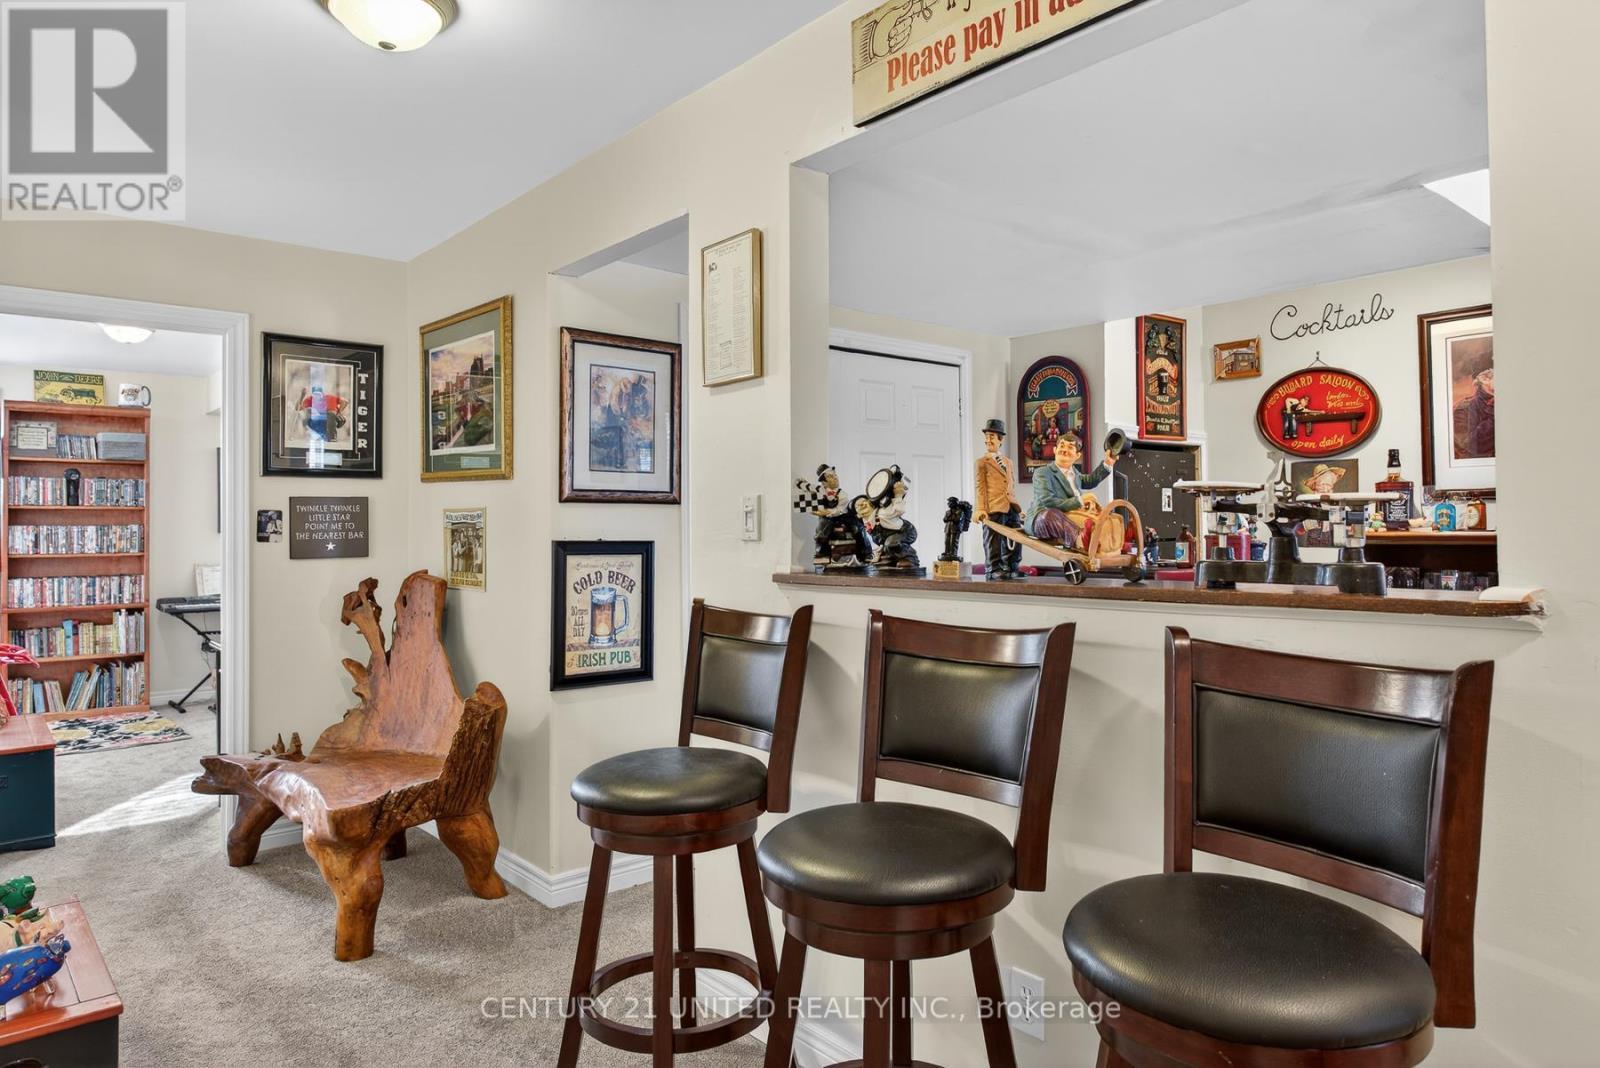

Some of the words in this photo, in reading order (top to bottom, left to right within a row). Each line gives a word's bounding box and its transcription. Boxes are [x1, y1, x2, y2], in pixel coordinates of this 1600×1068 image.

[886, 33, 956, 93] Please
[963, 7, 1006, 63] pay
[1270, 293, 1395, 341] Cocktails
[35, 370, 60, 381] JOHN
[1319, 374, 1356, 390] SALOON
[357, 373, 369, 449] TIGER
[1291, 440, 1317, 450] open
[1318, 435, 1345, 449] daily
[296, 505, 327, 513] TWINKLE
[329, 504, 361, 512] TWINKLE
[308, 513, 331, 522] LITTLE
[332, 513, 352, 521] STAR
[304, 522, 329, 531] POINT
[331, 522, 342, 530] ME
[344, 522, 355, 530] TO
[295, 532, 310, 540] THE
[312, 532, 346, 540] NEAREST
[348, 531, 364, 539] BAR
[573, 570, 603, 595] COLD
[607, 570, 636, 594] BEER
[576, 652, 607, 668] IRISH
[609, 650, 632, 665] PUB
